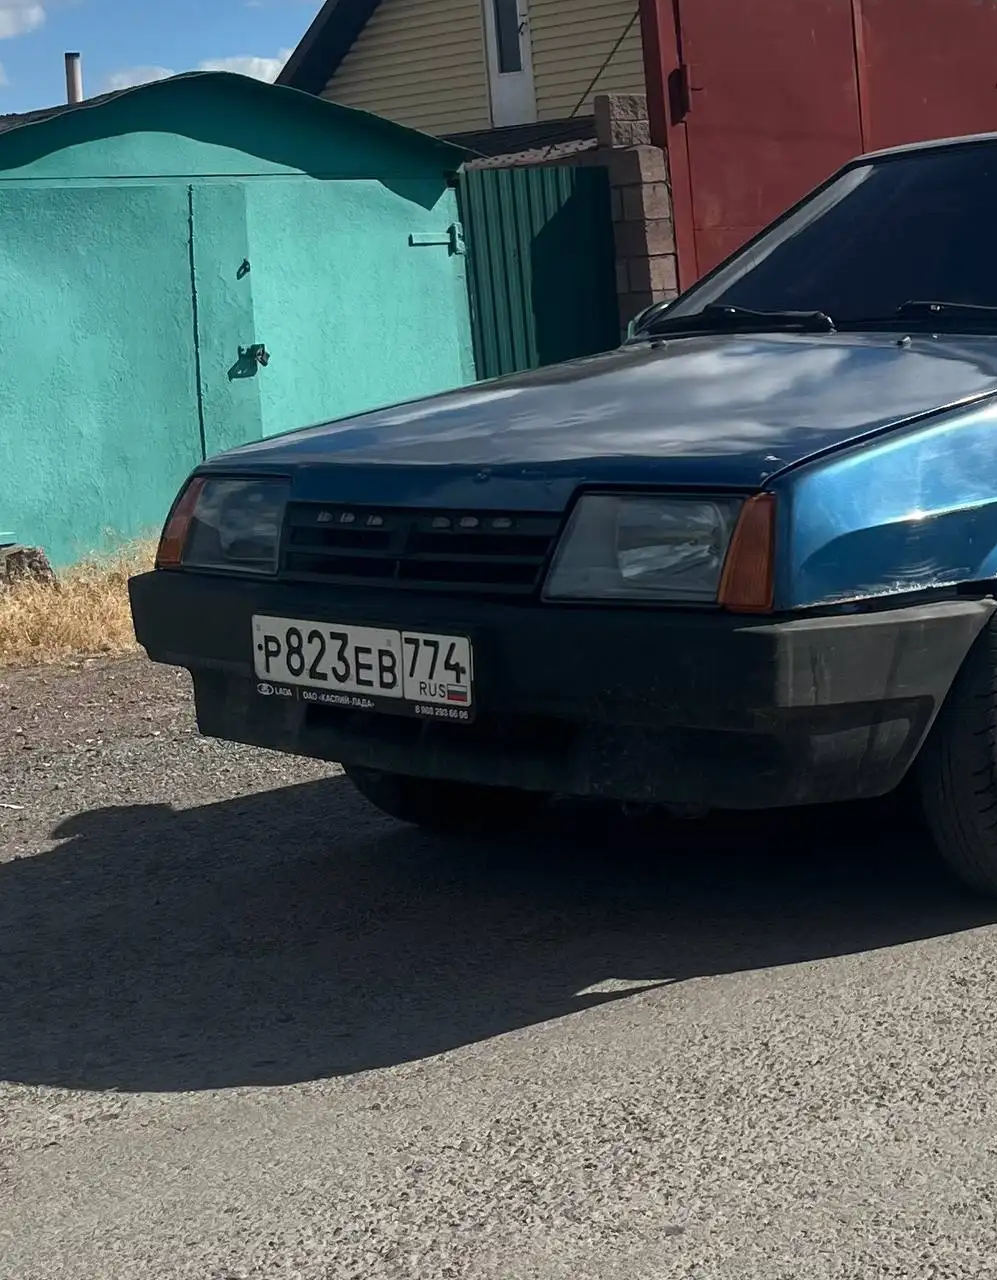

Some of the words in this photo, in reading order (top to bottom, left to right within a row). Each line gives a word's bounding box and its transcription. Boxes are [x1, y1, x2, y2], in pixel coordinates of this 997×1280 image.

[264, 627, 397, 689] Р823ЕВ
[404, 637, 466, 684] 774
[274, 687, 293, 697] LADA
[420, 681, 446, 698] RUS
